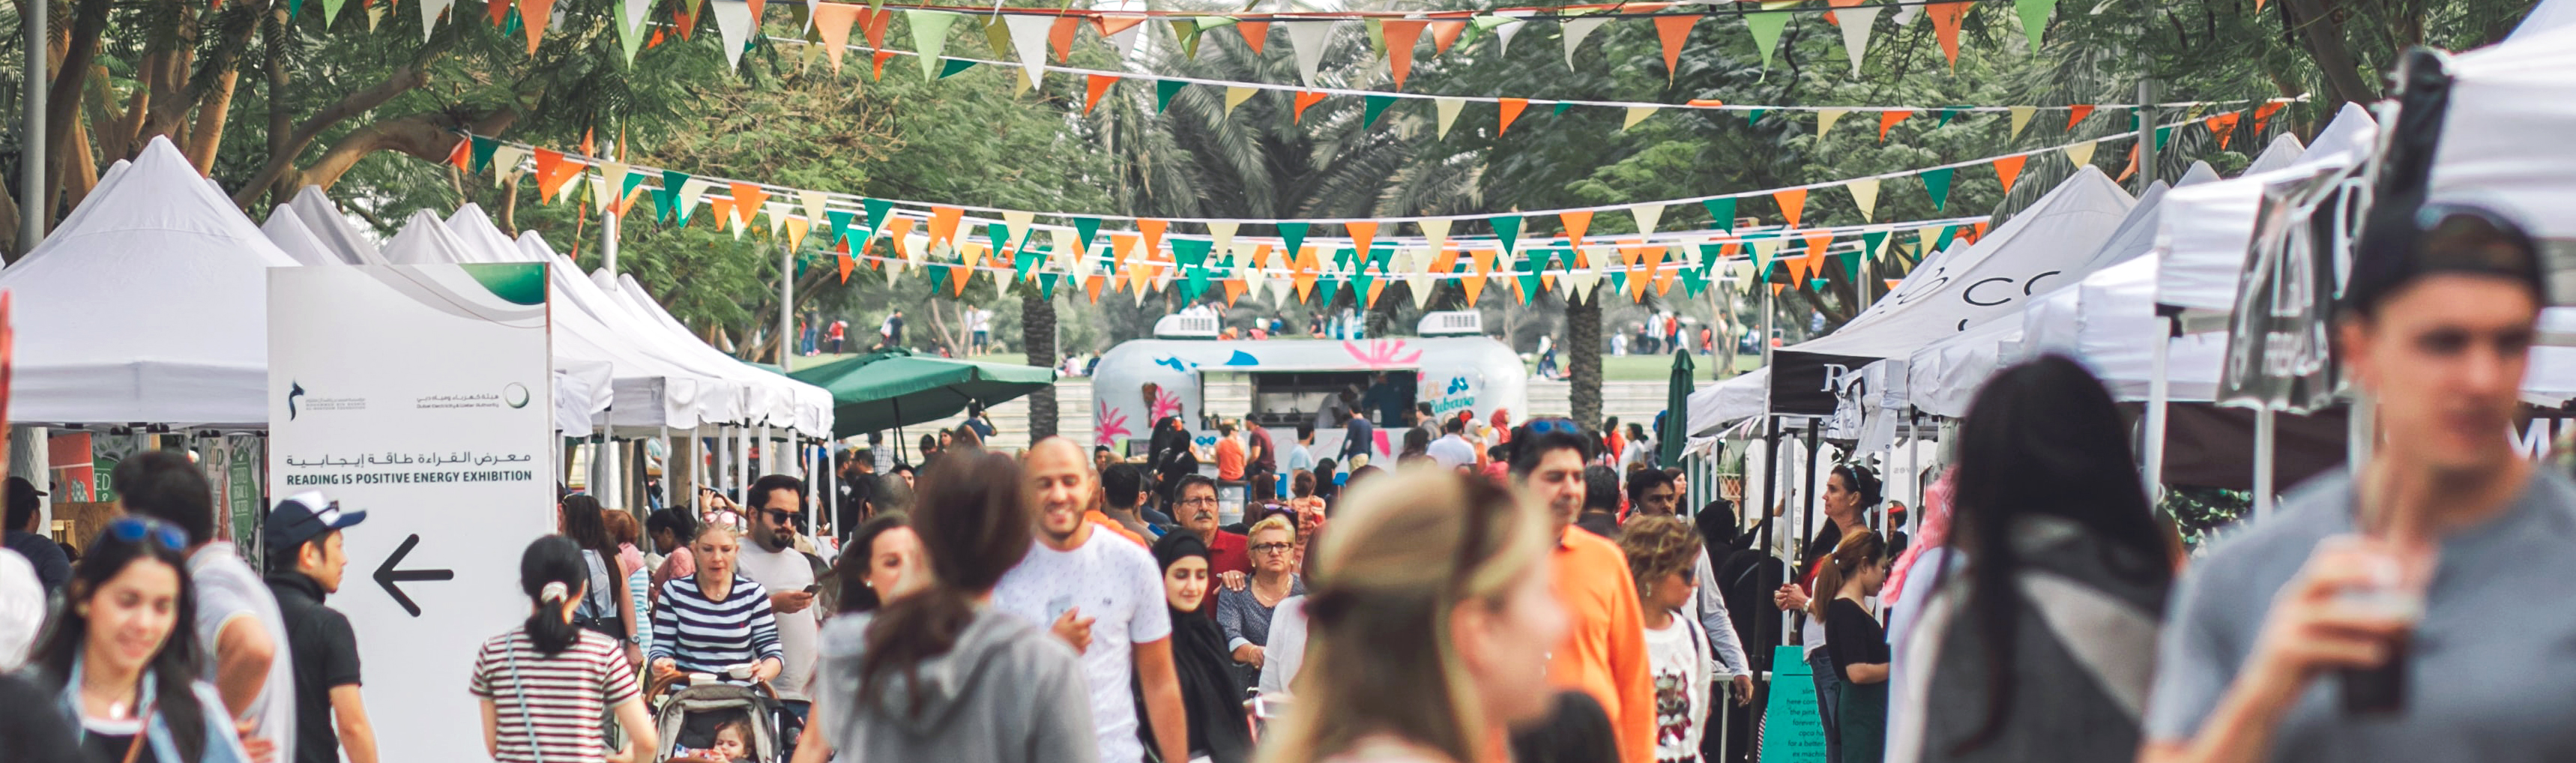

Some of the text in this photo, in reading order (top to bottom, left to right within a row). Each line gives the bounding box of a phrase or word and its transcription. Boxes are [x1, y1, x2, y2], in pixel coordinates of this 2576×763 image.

[286, 451, 531, 468] معرض القراءة طاقة إيجابية
[286, 470, 532, 486] READING IS POSITIVE ENERGY EXHIBITION
